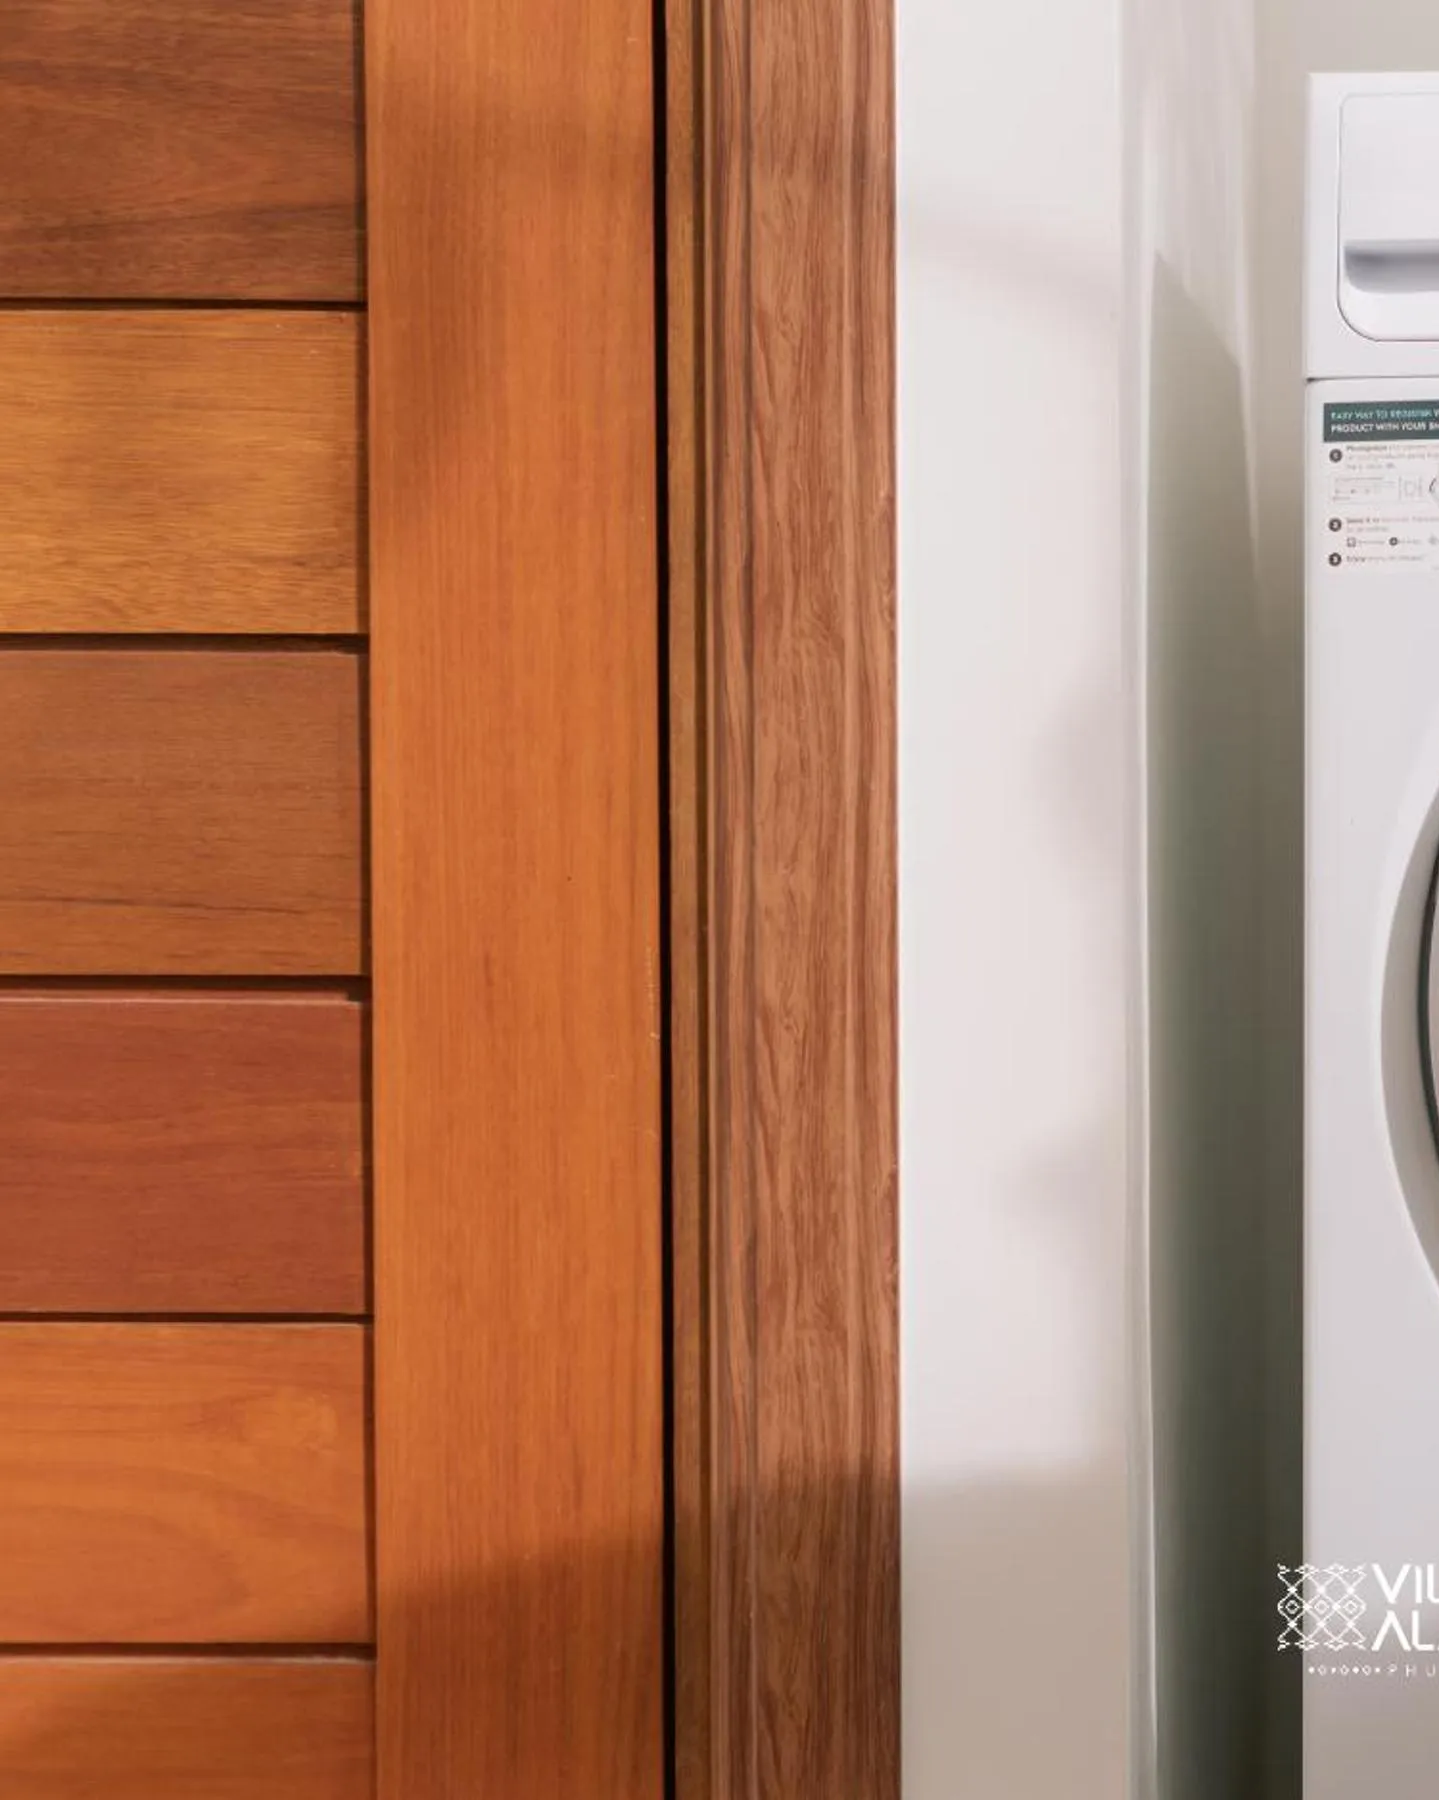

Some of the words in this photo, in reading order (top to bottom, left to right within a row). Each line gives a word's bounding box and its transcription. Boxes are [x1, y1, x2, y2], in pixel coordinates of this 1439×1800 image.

[1331, 422, 1374, 433] PRODUCT
[1376, 422, 1399, 432] WITH
[1402, 421, 1427, 432] YOUR
